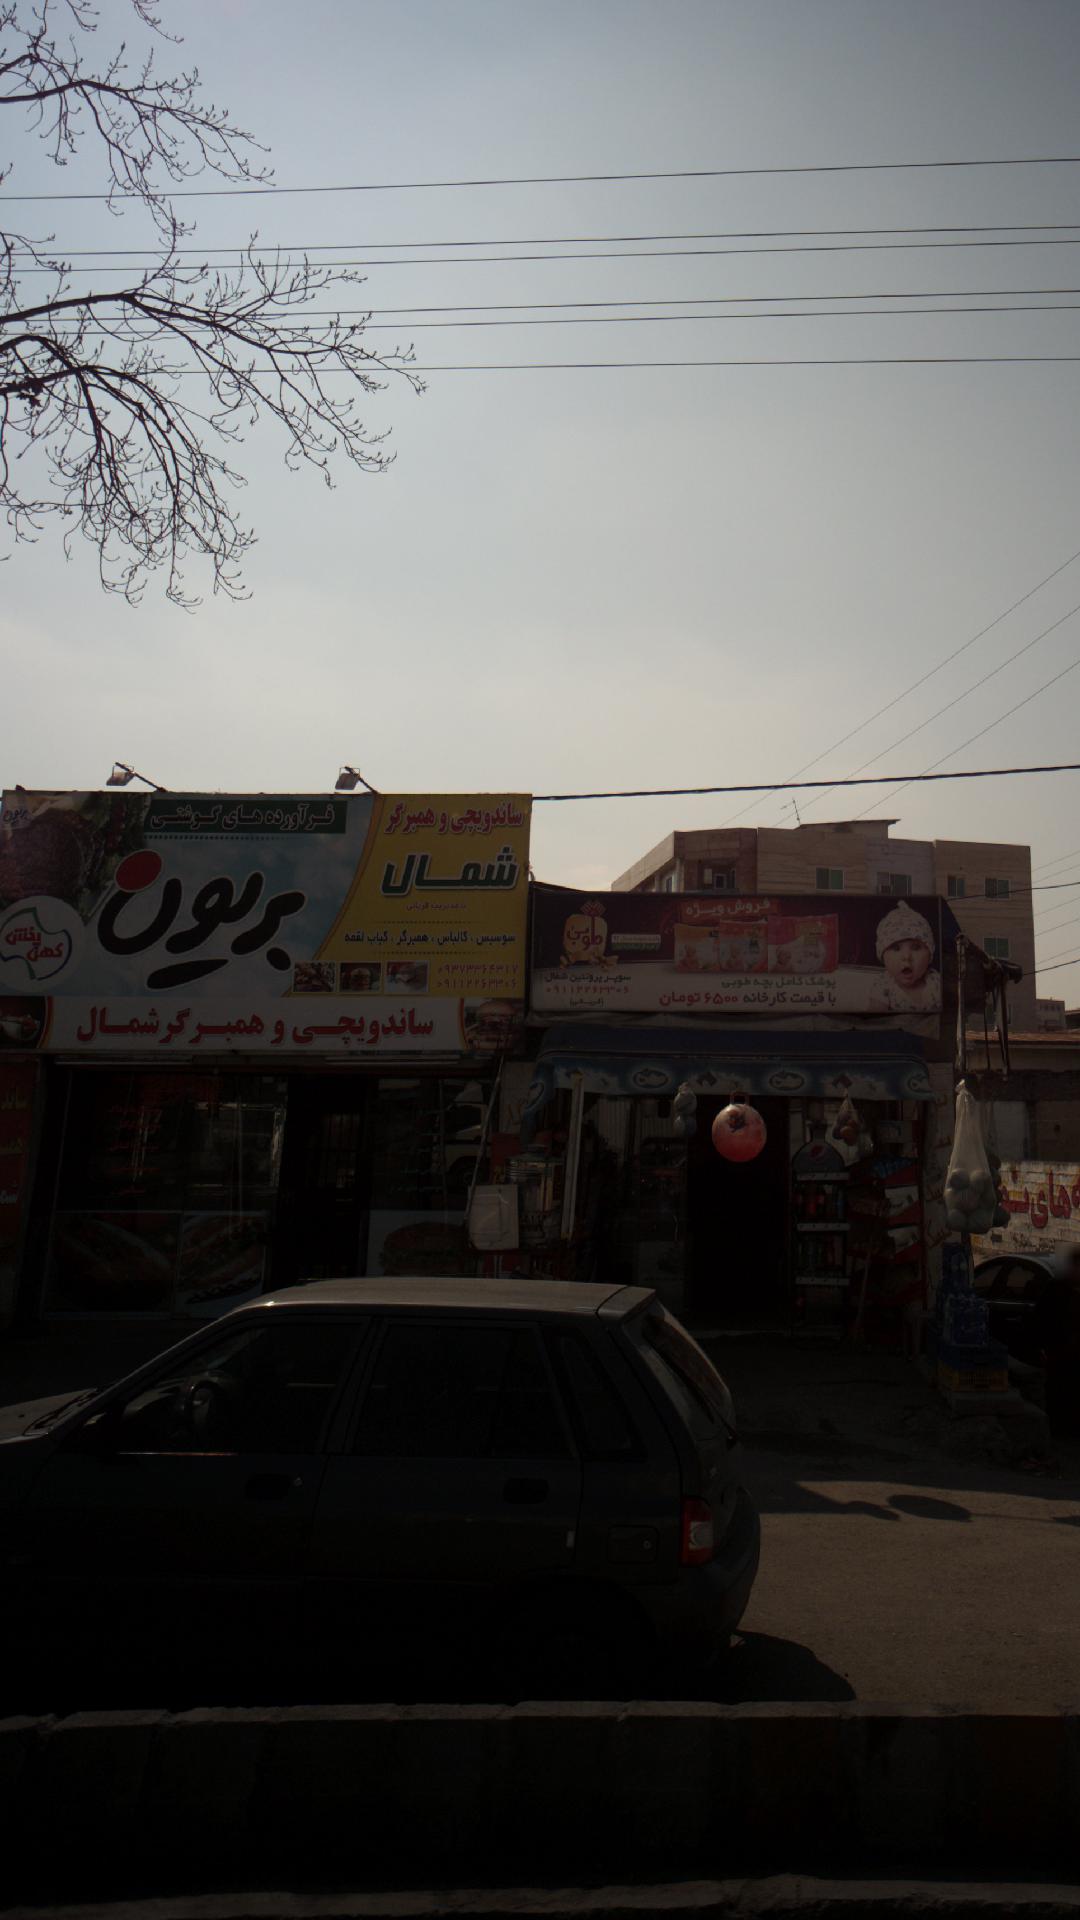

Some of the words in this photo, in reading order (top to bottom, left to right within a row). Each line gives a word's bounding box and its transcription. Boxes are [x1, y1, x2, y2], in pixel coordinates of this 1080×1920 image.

[150, 804, 223, 830] گوشتی
[222, 804, 265, 830] های
[267, 802, 336, 830] فرآورده
[384, 802, 437, 834] همبرگر
[439, 812, 448, 834] و
[450, 801, 525, 834] ساندویچی
[381, 846, 519, 895] شمال
[686, 902, 725, 918] ویژه
[727, 898, 770, 914] فروش
[368, 931, 389, 945] کباب
[397, 930, 430, 945] همبرگر
[437, 930, 469, 946] کالباس
[476, 932, 517, 946] سوسیس
[659, 992, 702, 1007] تومان
[704, 993, 739, 1005] ۶۵۰۰
[743, 991, 788, 1007] کارخانه
[790, 991, 826, 1006] قیمت
[827, 991, 837, 1007] با
[77, 1006, 160, 1042] شمال
[160, 1007, 265, 1044] همبرگر
[271, 1018, 285, 1043] و
[292, 1007, 434, 1044] ساندویچی
